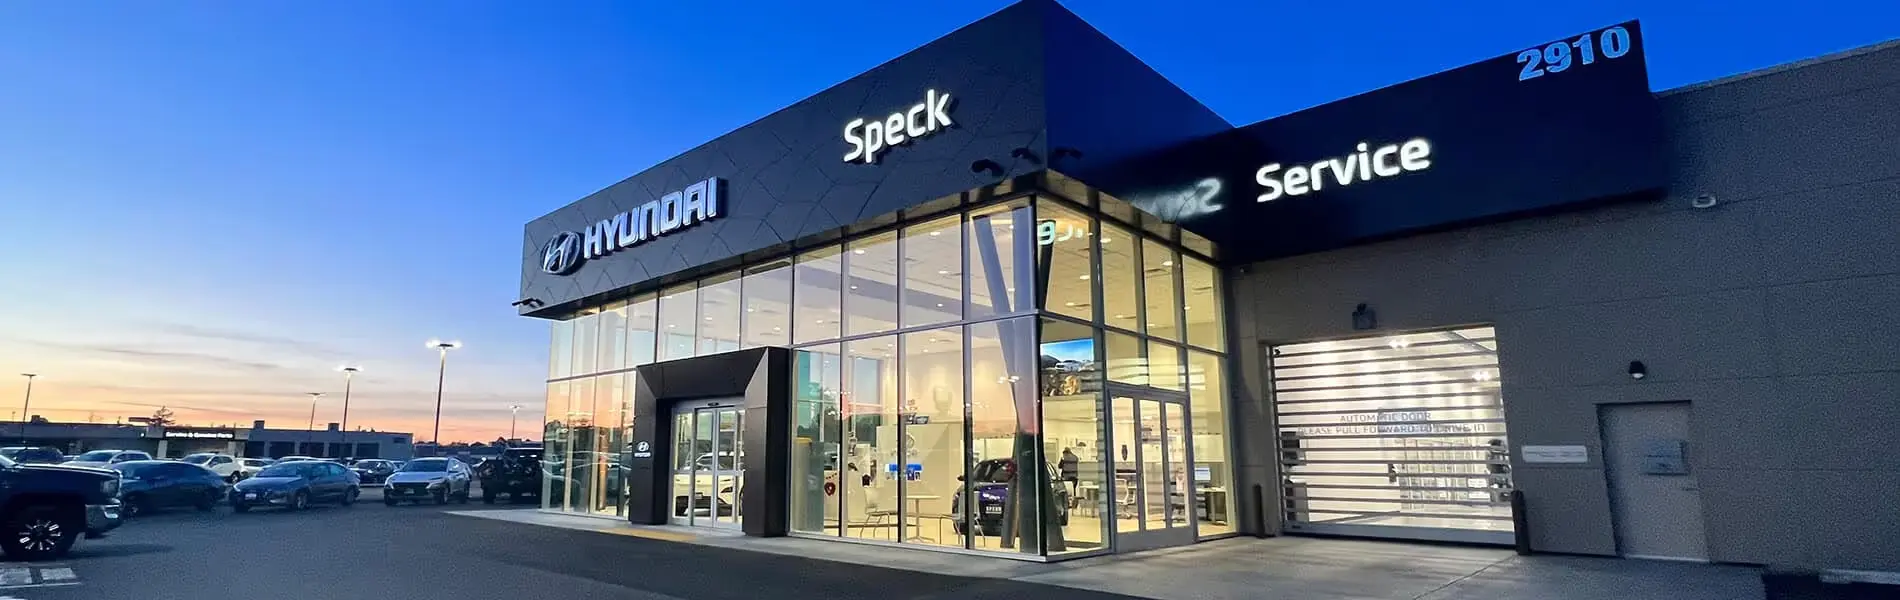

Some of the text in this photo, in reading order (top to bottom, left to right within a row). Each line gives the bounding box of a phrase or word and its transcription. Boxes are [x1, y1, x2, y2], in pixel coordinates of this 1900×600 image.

[1517, 26, 1631, 82] 2910
[843, 89, 953, 164] Speck
[1256, 137, 1432, 203] Service
[584, 176, 718, 260] HYUNDAI
[1336, 426, 1360, 435] PULL
[1401, 412, 1432, 422] DOOR
